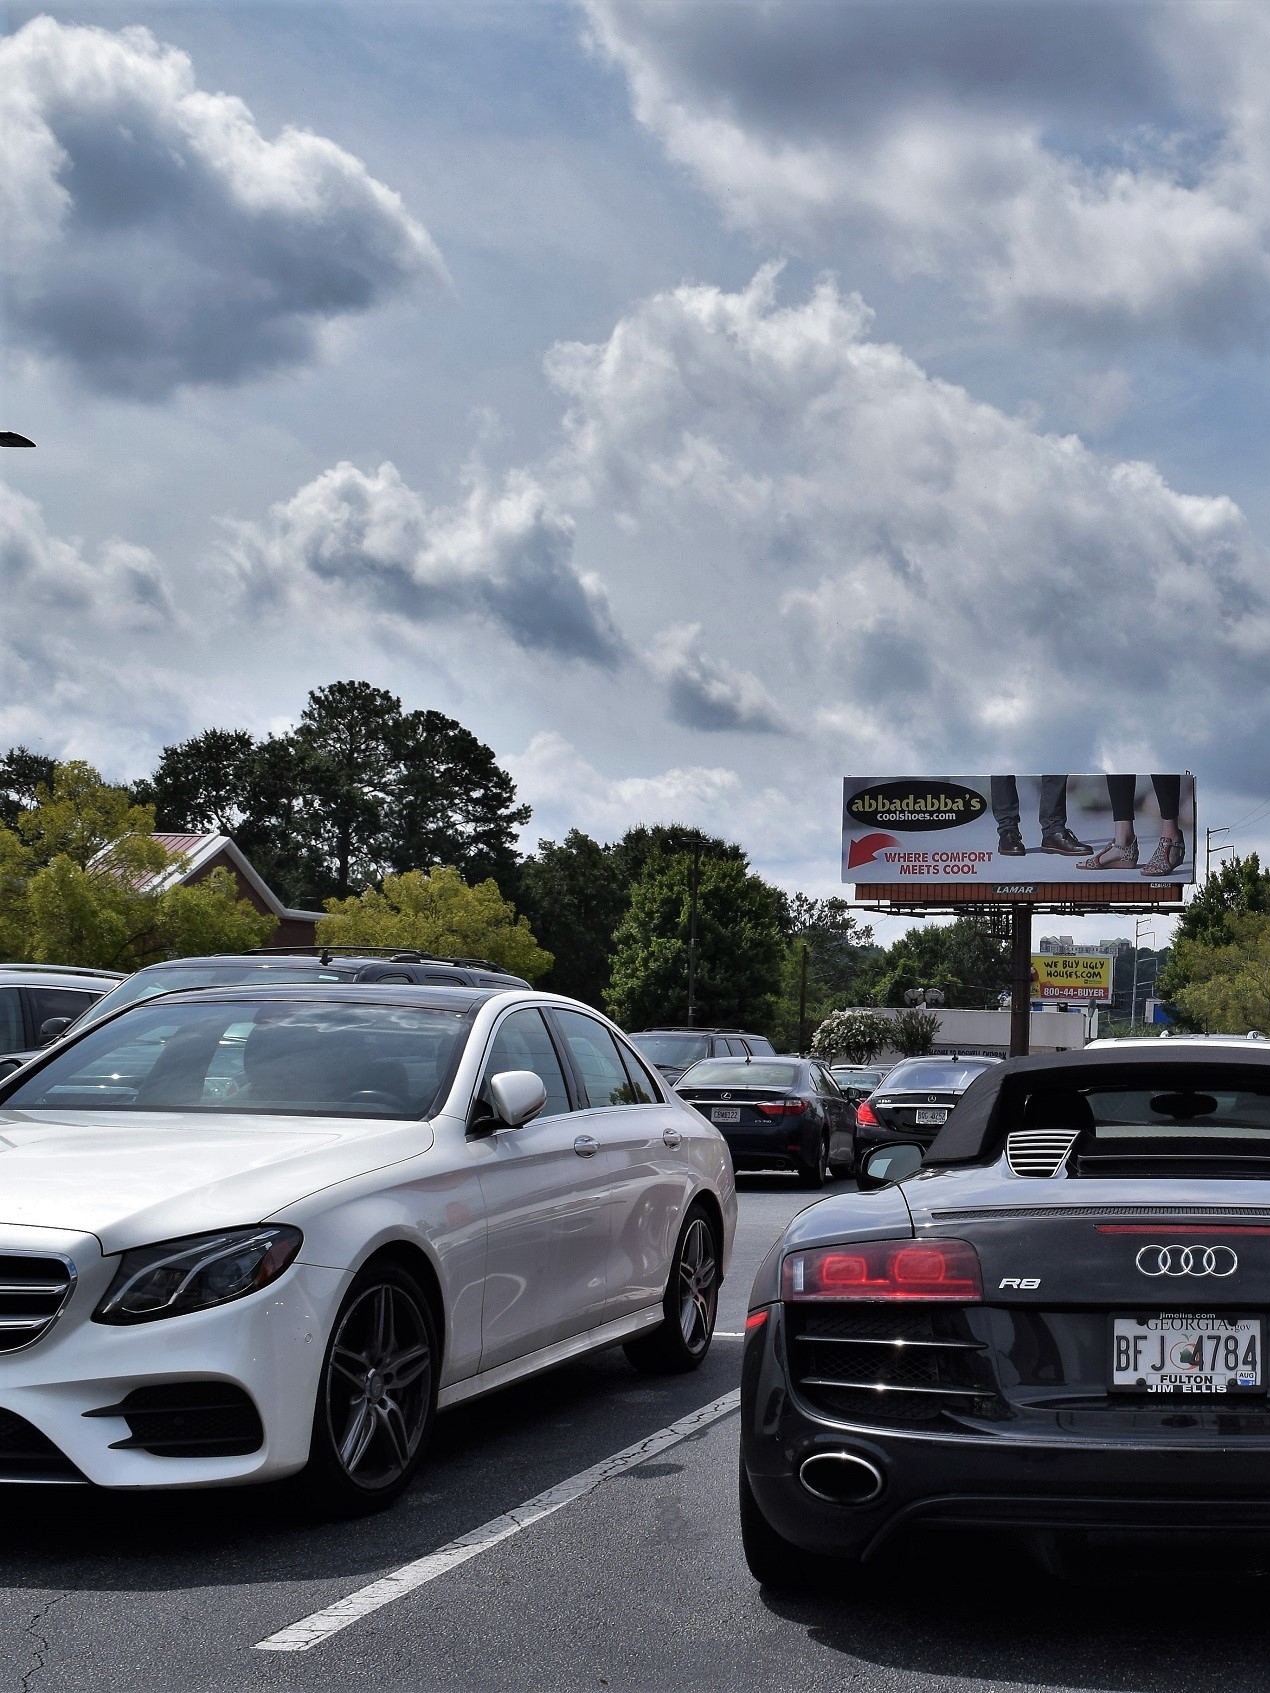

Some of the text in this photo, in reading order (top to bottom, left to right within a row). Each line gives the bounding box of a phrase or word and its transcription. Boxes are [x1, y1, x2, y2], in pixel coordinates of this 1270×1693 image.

[851, 793, 981, 812] abbadabba's
[876, 811, 956, 821] coolshoes.com
[884, 851, 993, 863] WHERE COMFORT
[899, 864, 978, 875] MEETS COOL
[996, 886, 1034, 894] LAMAR
[1043, 960, 1105, 970] WE BUY UGLY
[1046, 970, 1102, 979] HOUSES.COM
[1043, 987, 1104, 997] 800-44-BUYER
[999, 1277, 1041, 1290] R8
[1159, 1312, 1216, 1320] jimellis.com
[1160, 1374, 1213, 1384] FULTON
[1147, 1384, 1228, 1393] JIM ELLIS
